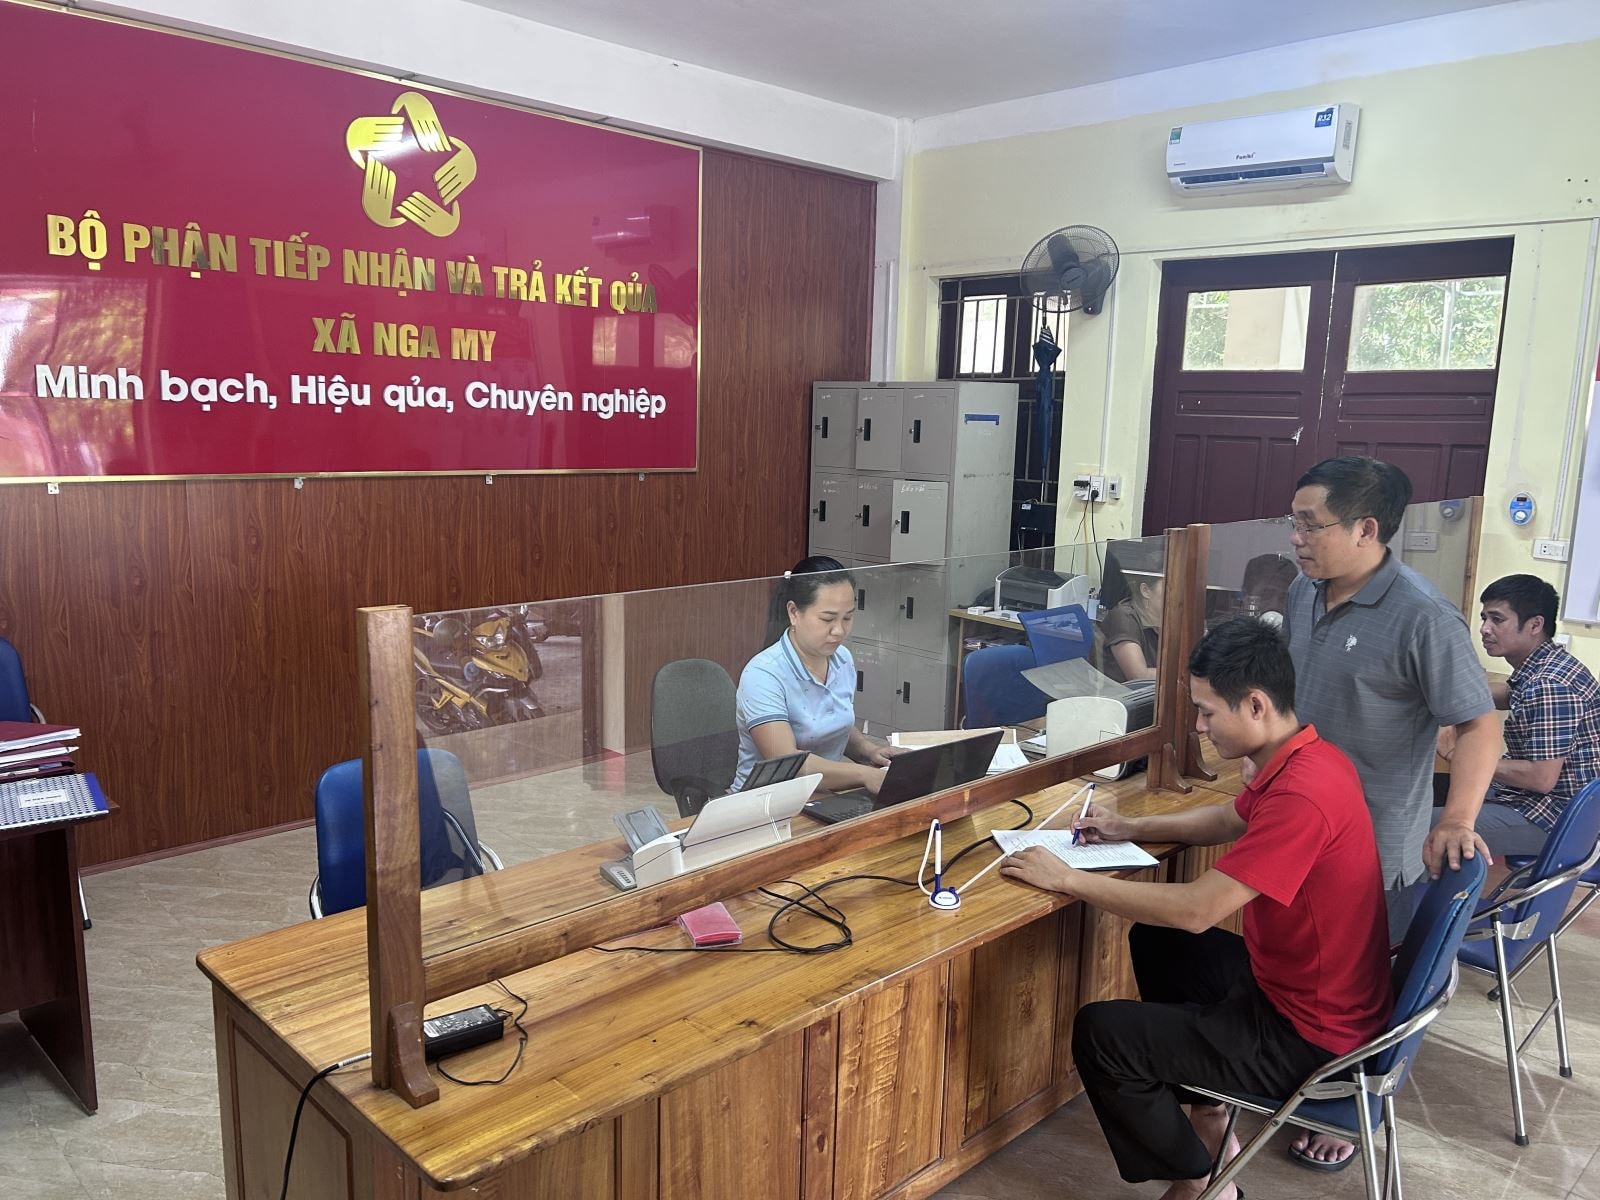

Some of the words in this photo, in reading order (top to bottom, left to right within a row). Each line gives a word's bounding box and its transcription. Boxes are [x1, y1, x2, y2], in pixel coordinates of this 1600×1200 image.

[47, 209, 108, 271] BỘ
[122, 222, 238, 279] PHẬN
[249, 231, 331, 281] TIẾP
[343, 247, 436, 297] NHẬN
[446, 255, 484, 296] VÀ
[492, 259, 547, 303] TRẢ
[555, 266, 602, 308] KẾT
[609, 271, 658, 314] QỦA
[312, 312, 361, 355] XÃ
[373, 321, 441, 359] NGA
[451, 327, 497, 362] MY
[35, 364, 144, 400] Minh
[160, 369, 278, 411] bạch,
[290, 374, 371, 414] Hiệu
[383, 376, 454, 413] qủa,
[465, 381, 574, 416] Chuyên
[582, 388, 668, 419] nghiệp
